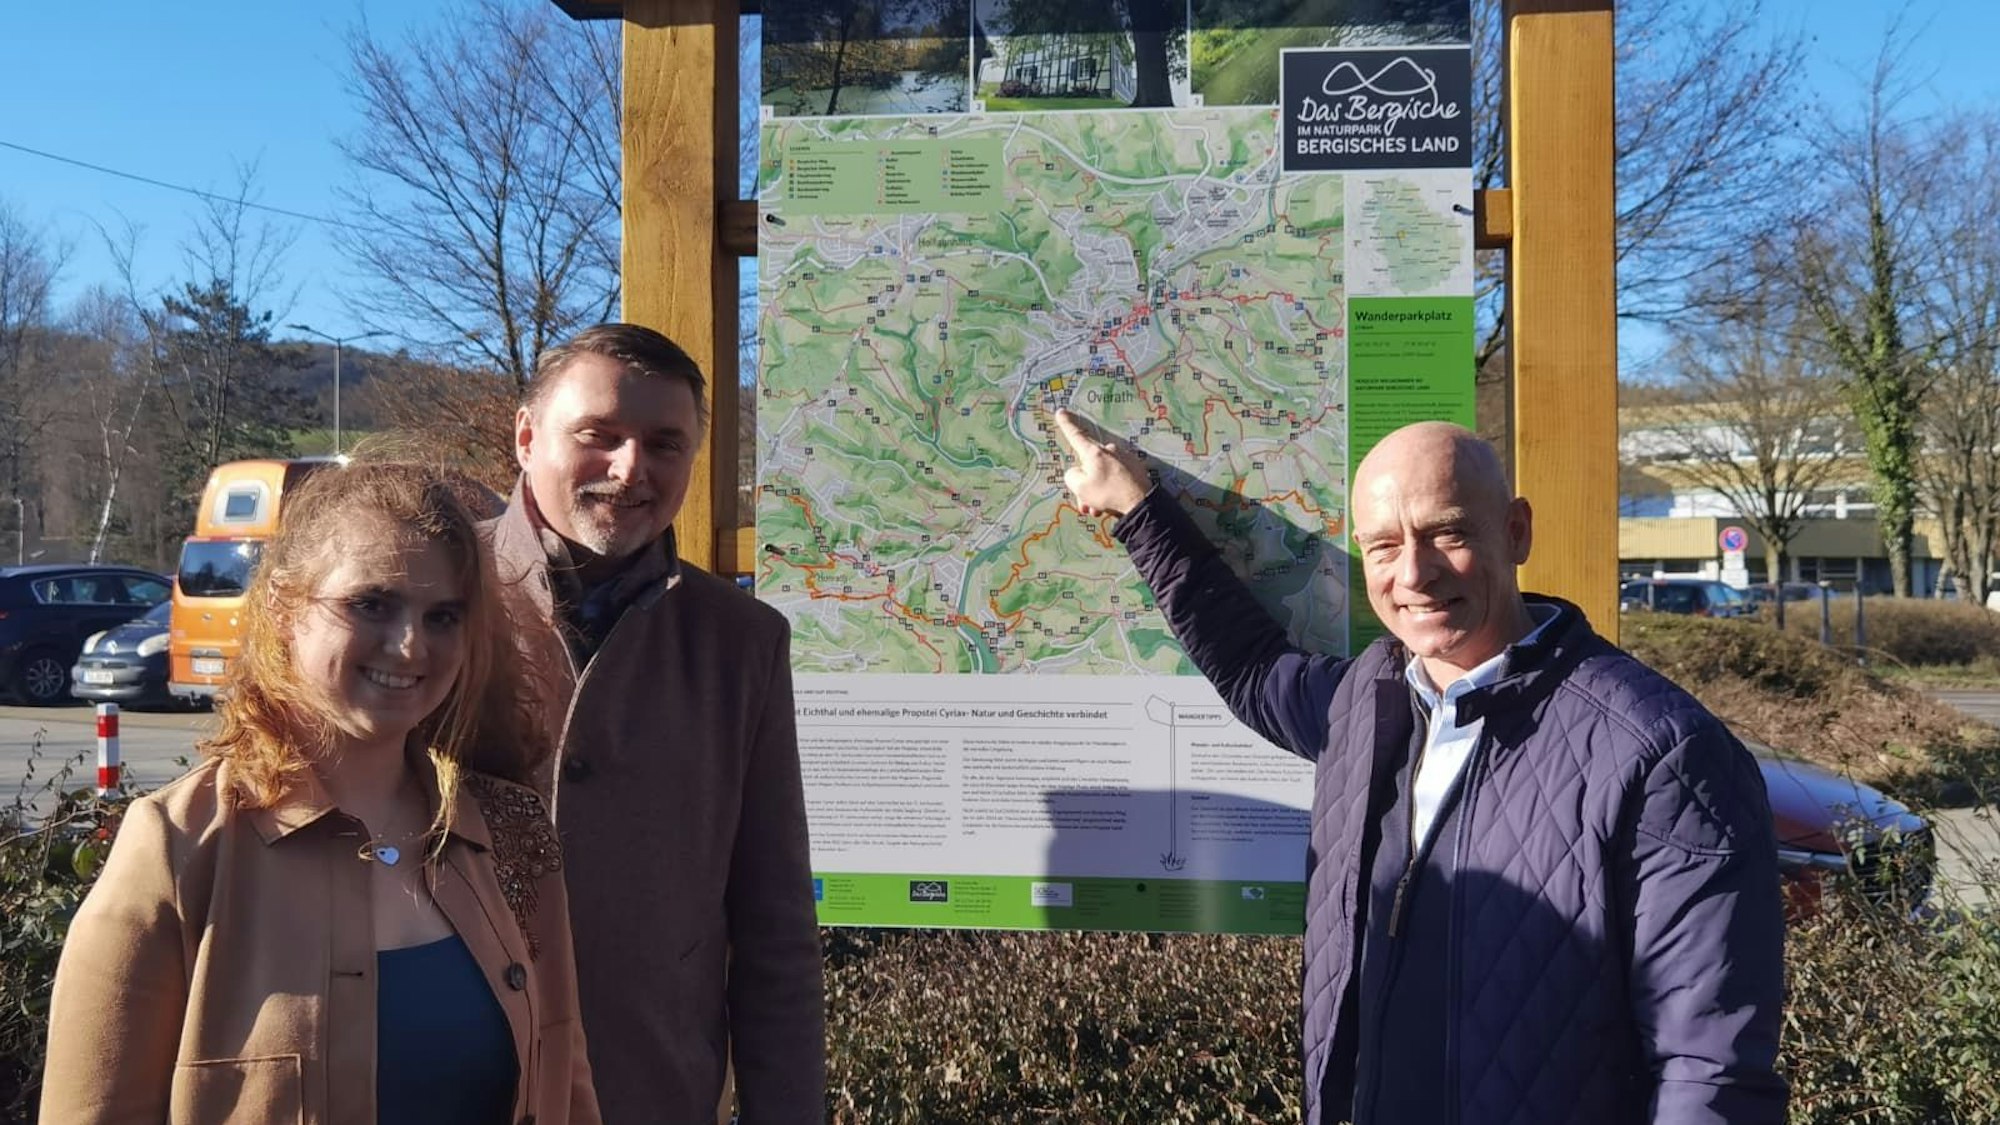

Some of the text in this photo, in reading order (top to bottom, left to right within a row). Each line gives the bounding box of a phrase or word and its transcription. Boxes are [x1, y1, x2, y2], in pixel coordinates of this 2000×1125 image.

[1298, 95, 1460, 136] Das Bergische
[1297, 124, 1382, 136] IM NATURPARK
[1297, 136, 1459, 155] BERGISCHES LAND
[1355, 310, 1453, 323] Wanderparkplatz
[1087, 390, 1134, 403] Overath
[803, 707, 837, 717] Eichthal
[839, 708, 855, 717] und
[856, 708, 900, 719] ehemalige
[902, 708, 937, 720] Propstei
[971, 709, 996, 718] Natur
[998, 709, 1015, 718] und
[1016, 710, 1065, 719] Geschichte
[1066, 710, 1108, 719] verbindet
